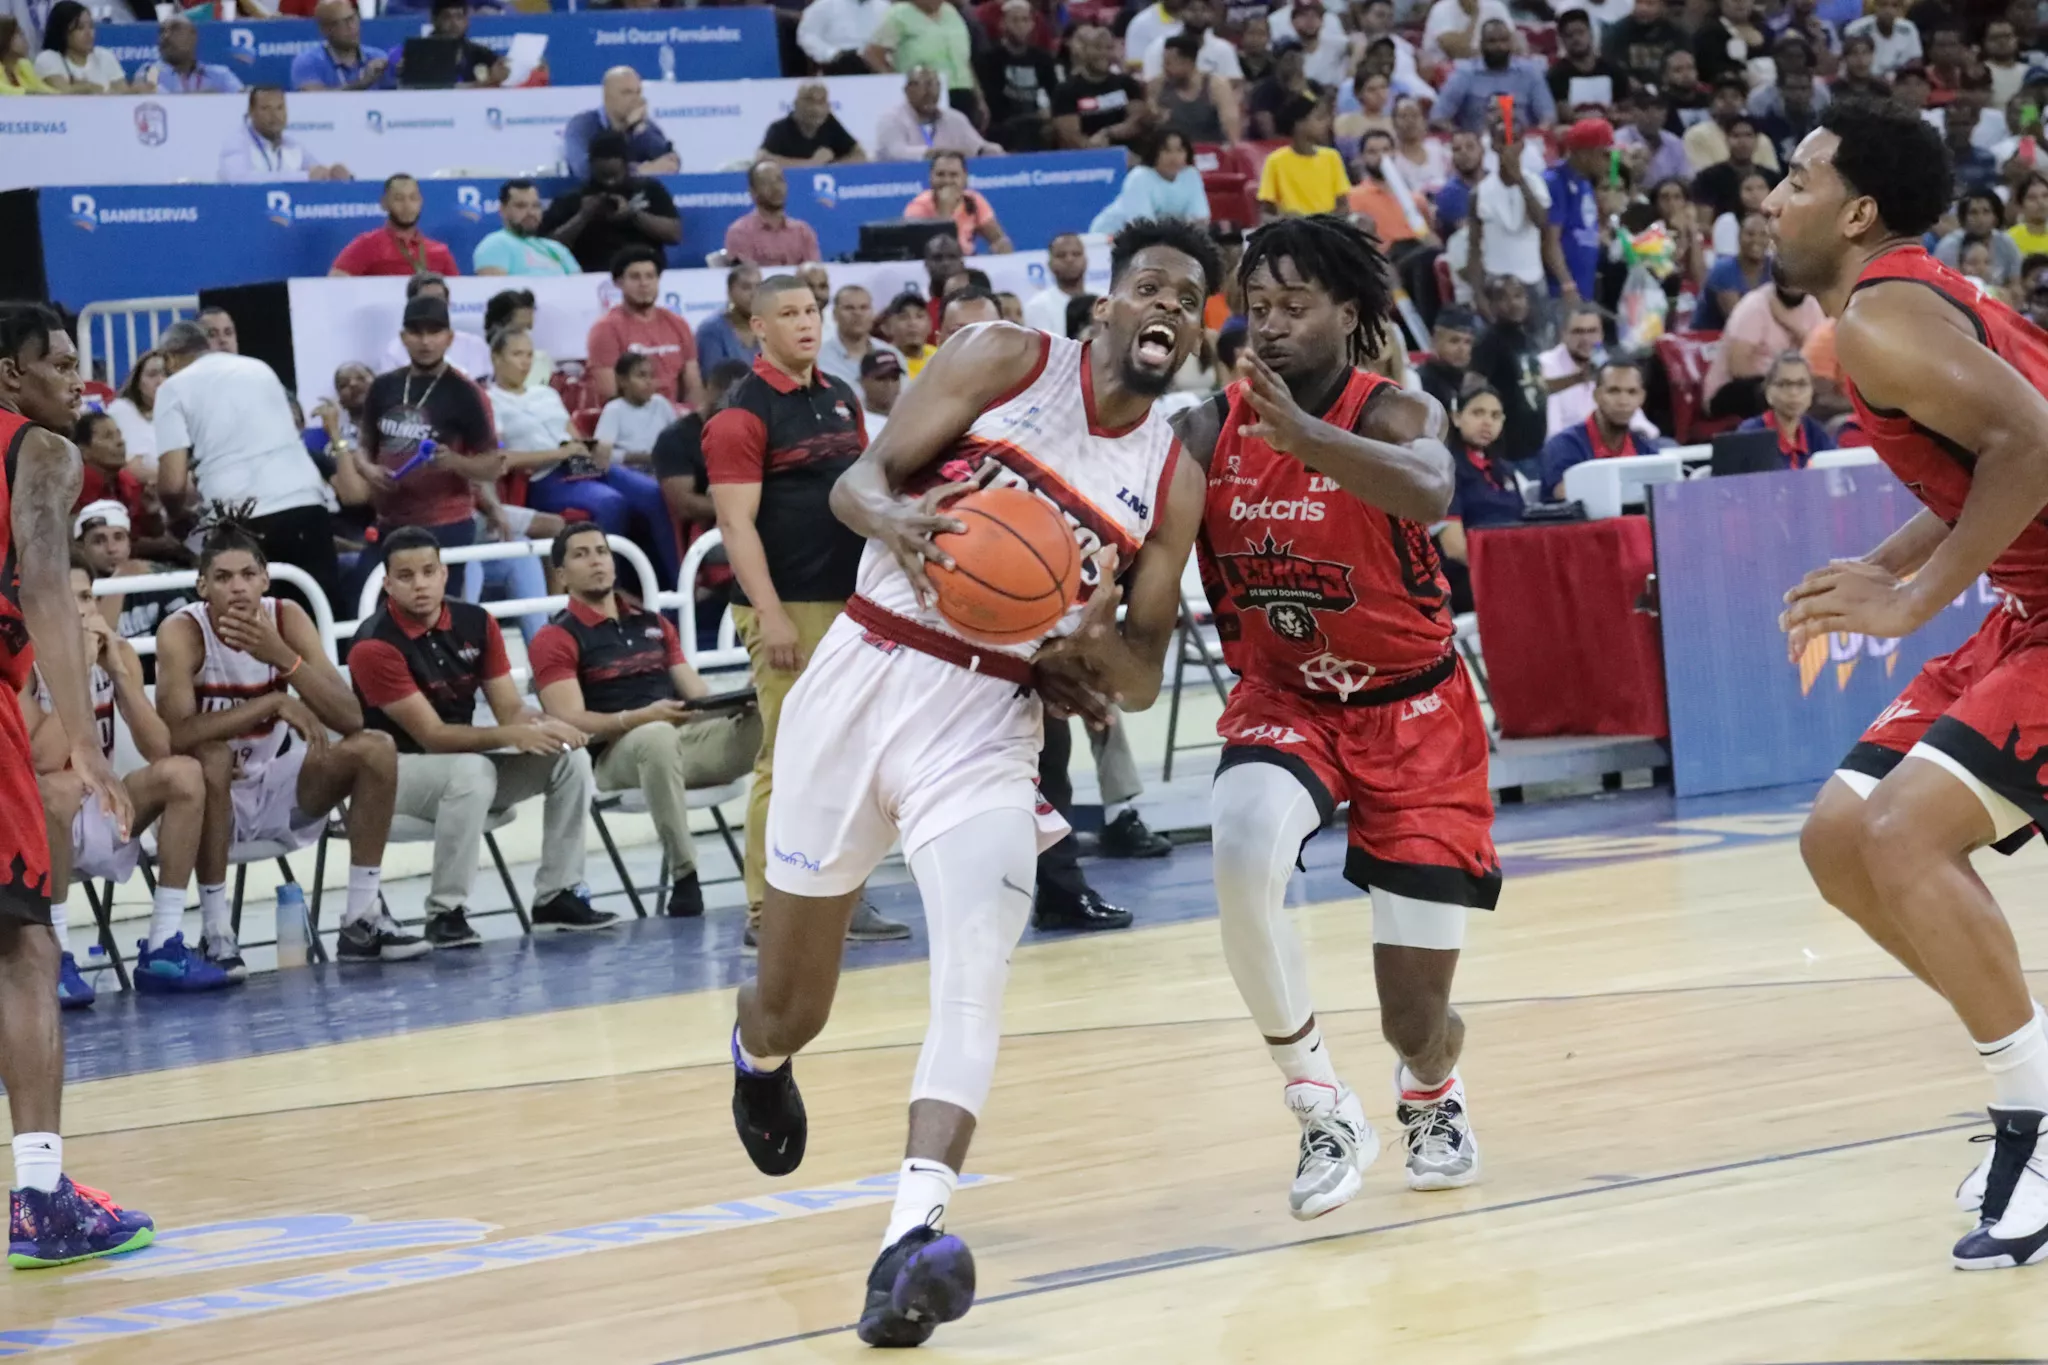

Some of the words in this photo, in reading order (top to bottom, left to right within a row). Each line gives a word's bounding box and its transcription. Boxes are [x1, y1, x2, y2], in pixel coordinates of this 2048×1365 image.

[99, 206, 198, 224] BANRESERVAS
[1308, 476, 1341, 492] LN
[1116, 486, 1149, 520] LNB
[1229, 496, 1326, 521] betcris
[1278, 589, 1323, 600] DOMINGO
[1402, 692, 1442, 721] LNB
